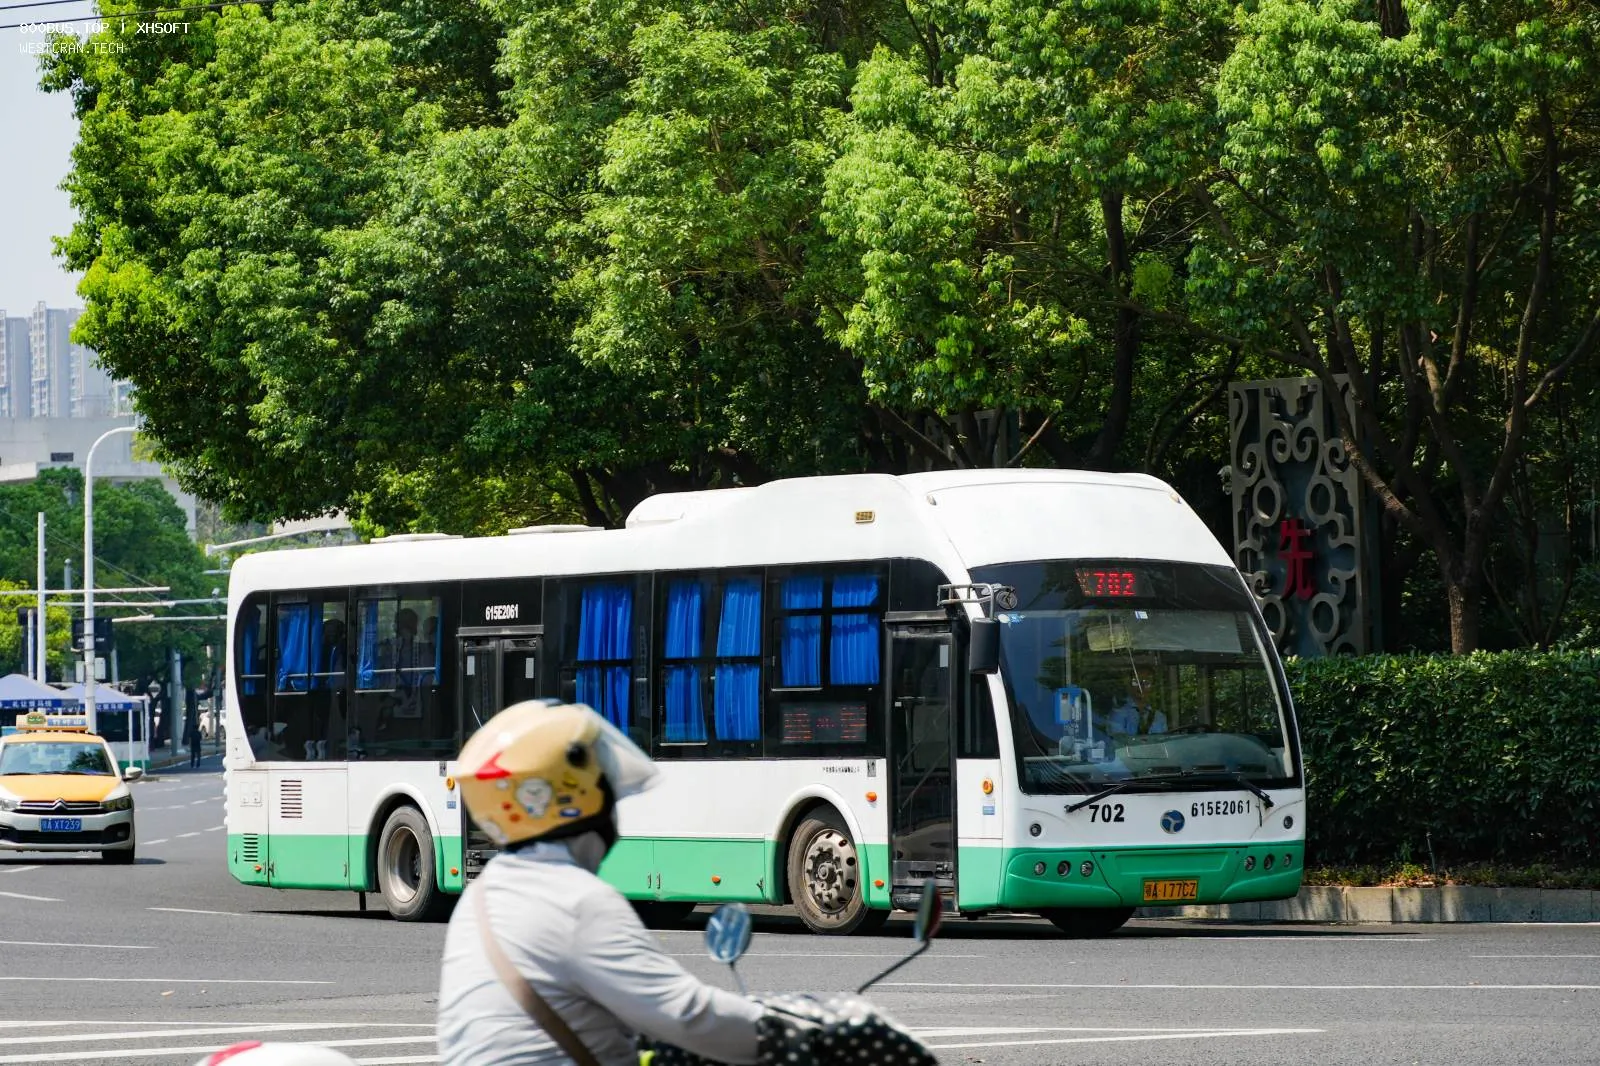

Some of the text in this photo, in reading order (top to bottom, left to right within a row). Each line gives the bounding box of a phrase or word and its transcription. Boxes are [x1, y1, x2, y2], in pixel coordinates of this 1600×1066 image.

[1278, 518, 1314, 600] 先
[485, 604, 519, 620] 615E2061
[1088, 803, 1125, 823] 702
[1191, 800, 1251, 817] 615E2061
